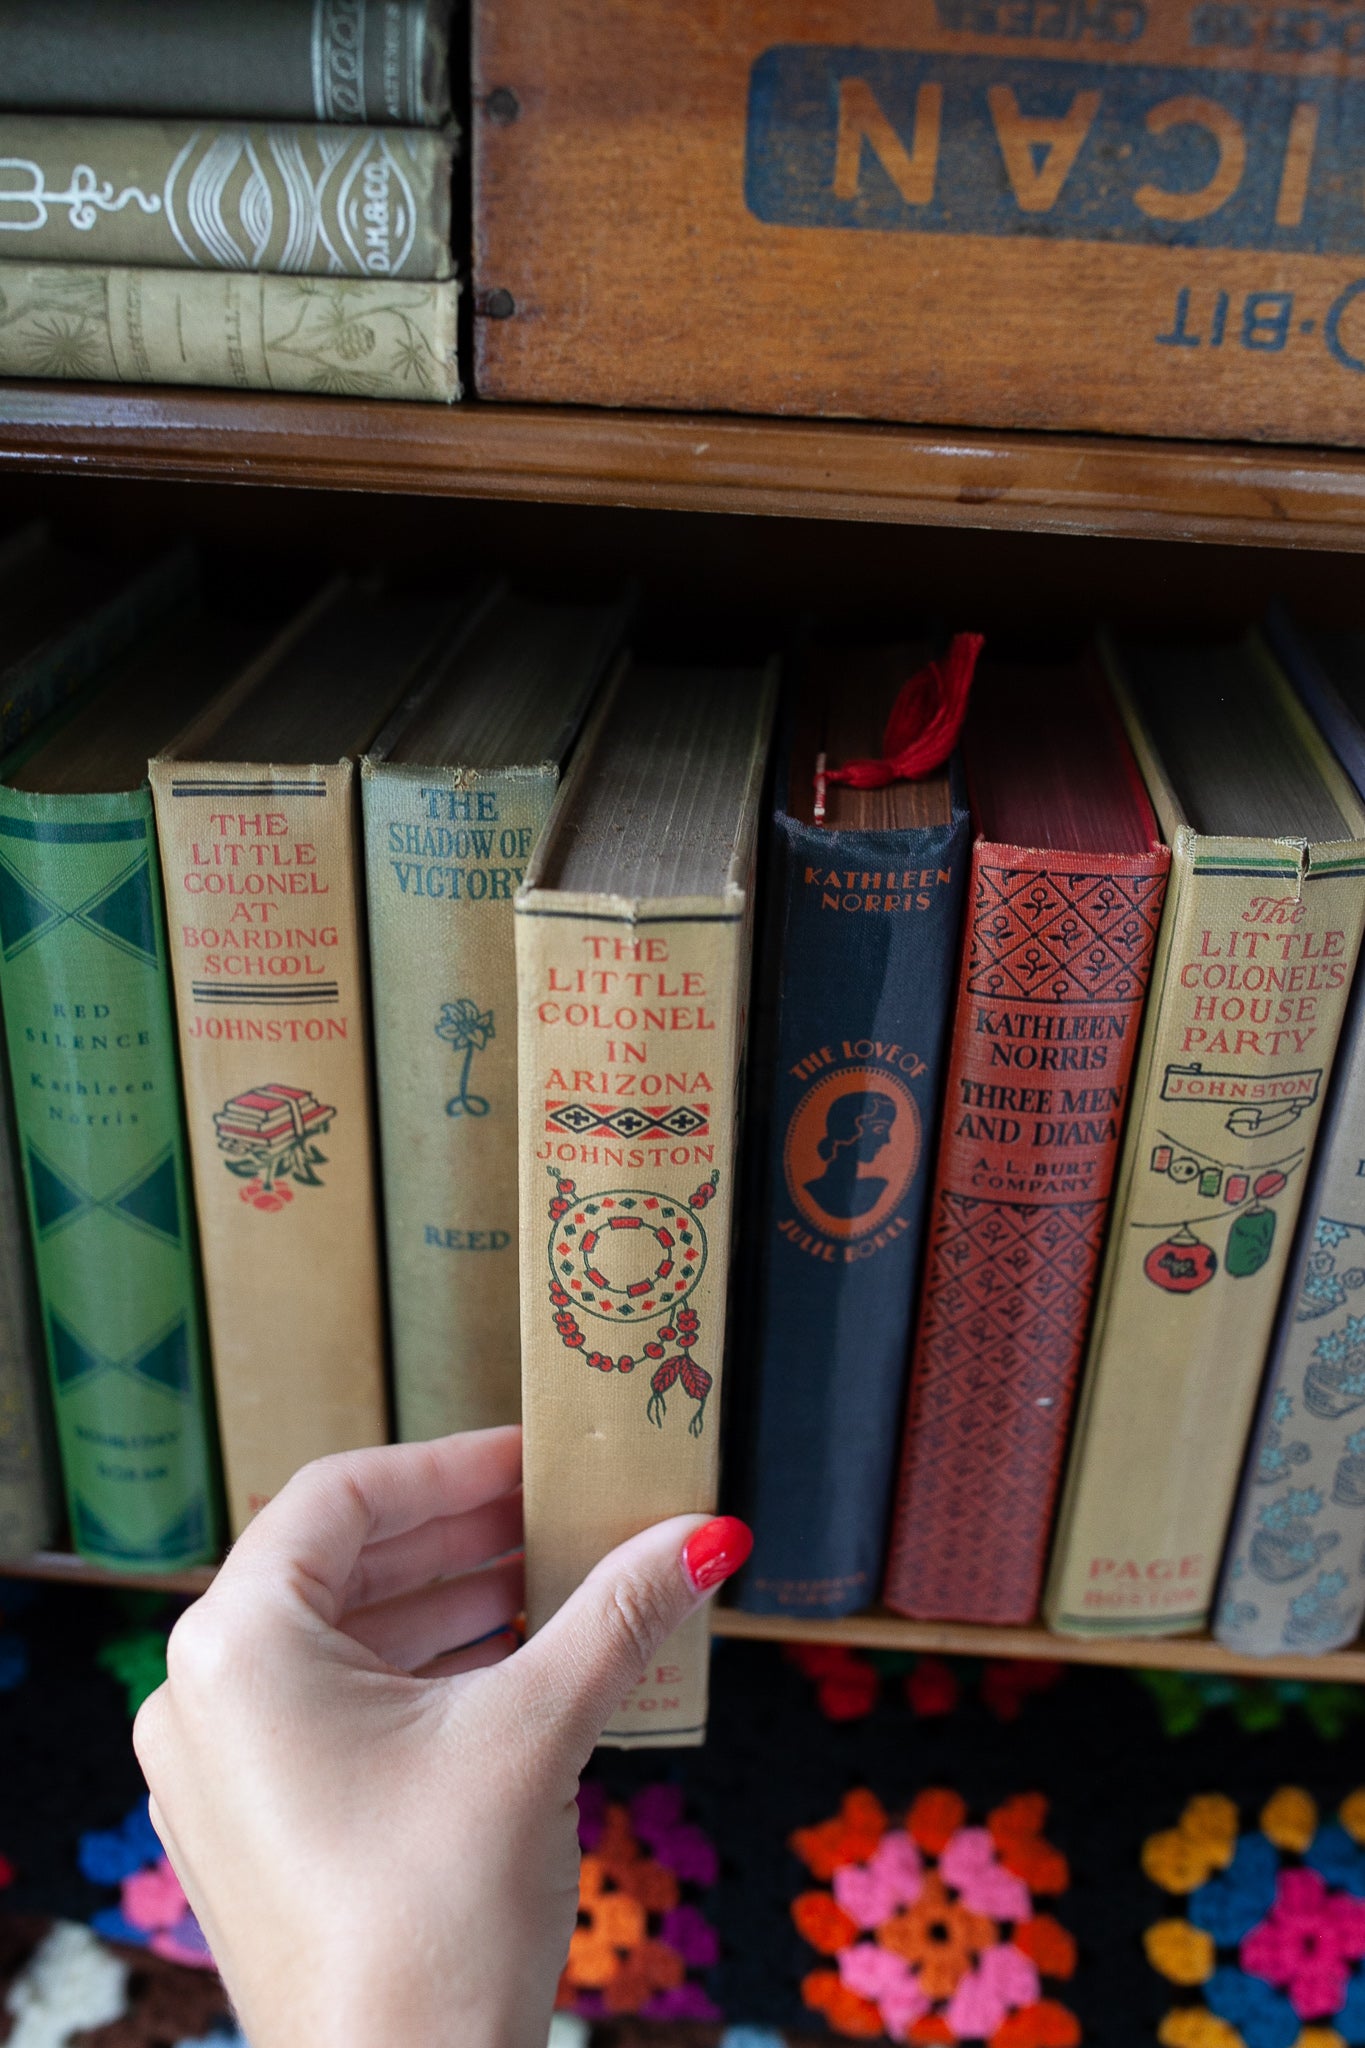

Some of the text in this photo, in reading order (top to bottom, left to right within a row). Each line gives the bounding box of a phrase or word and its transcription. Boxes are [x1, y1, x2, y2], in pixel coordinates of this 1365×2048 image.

[832, 77, 1365, 229] ICAN
[421, 788, 499, 822] THE
[210, 813, 288, 837] THE
[193, 843, 316, 866] LITTLE
[388, 822, 533, 860] SHADOW OF
[184, 873, 329, 895] COLONEL
[804, 866, 952, 891] KATHLEEN
[230, 902, 278, 923] AT
[821, 892, 931, 913] NORRIS
[1242, 896, 1307, 925] The
[183, 926, 339, 950] BOARDING
[582, 935, 669, 963] THE
[1198, 930, 1345, 960] LITTLE
[204, 955, 325, 977] SCHOOL
[1180, 962, 1348, 993] COLONEL'S
[548, 967, 707, 998] LITTLE
[53, 1003, 110, 1019] RED
[538, 1002, 715, 1032] COLONEL
[976, 1009, 1129, 1040] KATHLEEN
[1193, 996, 1318, 1025] HOUSE
[26, 1027, 149, 1050] SILENCE
[189, 1016, 348, 1043] JOHNSTON
[1180, 1027, 1317, 1056] PARTY
[606, 1040, 648, 1065] IN
[789, 1039, 929, 1082] THE LOVE OF
[990, 1042, 1108, 1071] NORRIS
[30, 1072, 153, 1096] Kathleen
[544, 1069, 713, 1097] ARIZONA
[960, 1079, 1125, 1114] THREE MEN
[1168, 1077, 1316, 1100] JOHNSTON
[49, 1104, 138, 1126] Norris
[955, 1114, 1119, 1147] AND DIANA
[536, 1141, 715, 1169] JOHNSTON
[1034, 1160, 1097, 1176] BURT
[971, 1174, 1095, 1195] COMPANY
[424, 1225, 511, 1254] REED
[777, 1218, 837, 1263] JULIE
[1088, 1553, 1204, 1582] PAGE
